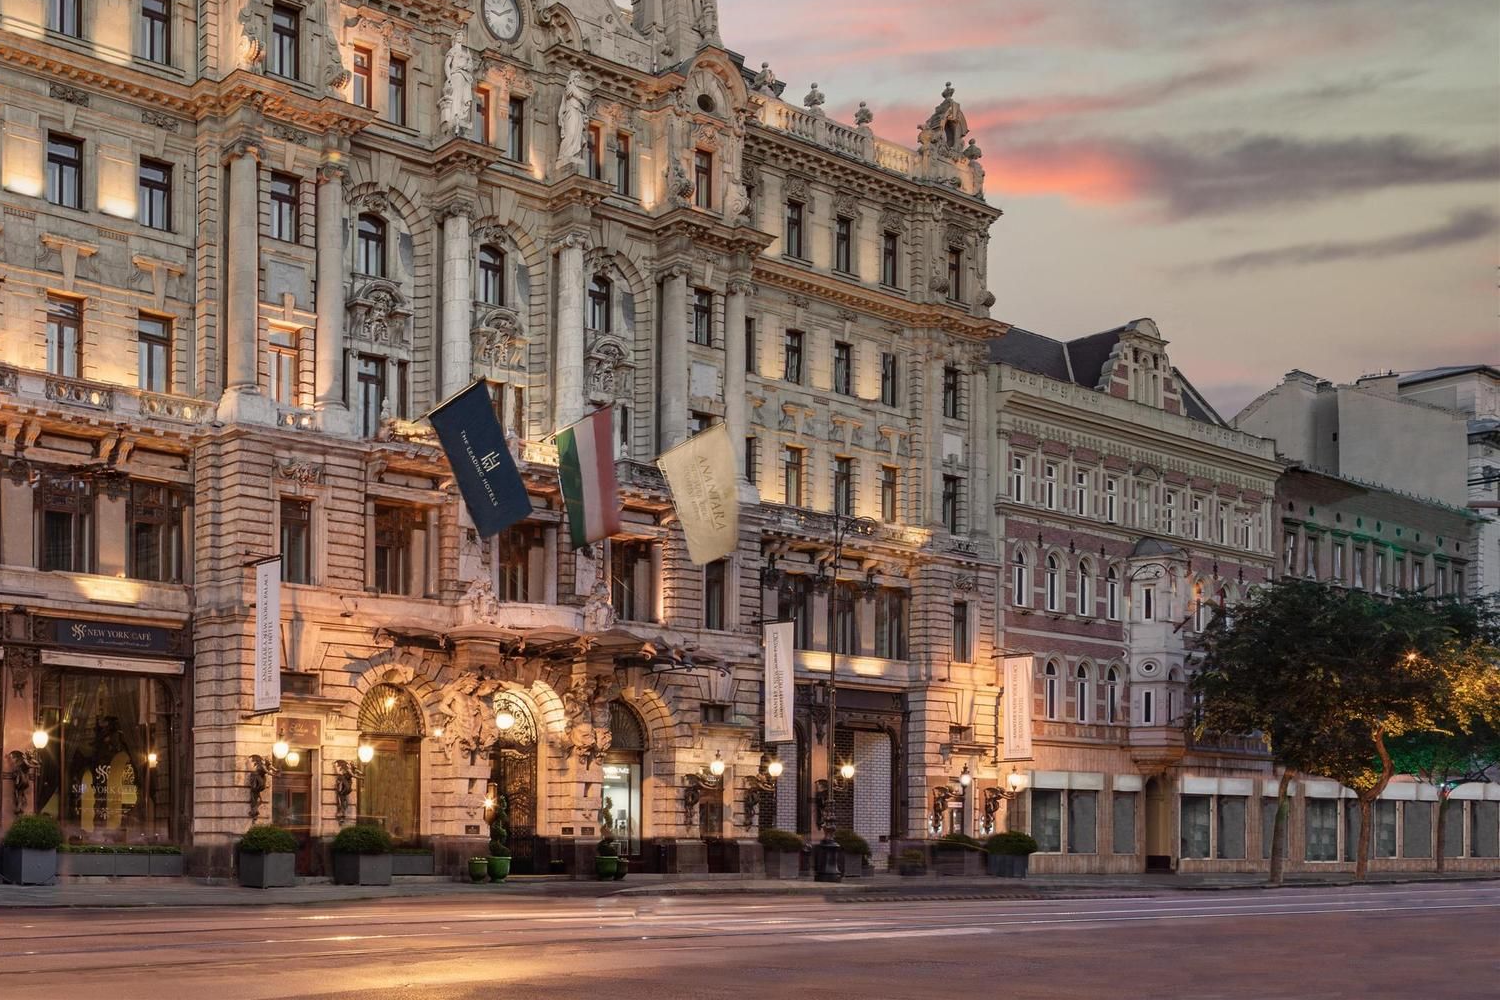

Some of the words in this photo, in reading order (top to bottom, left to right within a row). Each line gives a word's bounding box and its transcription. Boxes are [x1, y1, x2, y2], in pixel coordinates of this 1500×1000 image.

[460, 429, 470, 446] THE
[466, 446, 485, 477] LEADING
[481, 478, 499, 507] HOTELS
[697, 455, 727, 530] ANANTARA
[87, 628, 105, 637] NEW
[107, 629, 130, 639] YORK
[131, 631, 152, 640] CAFÉ
